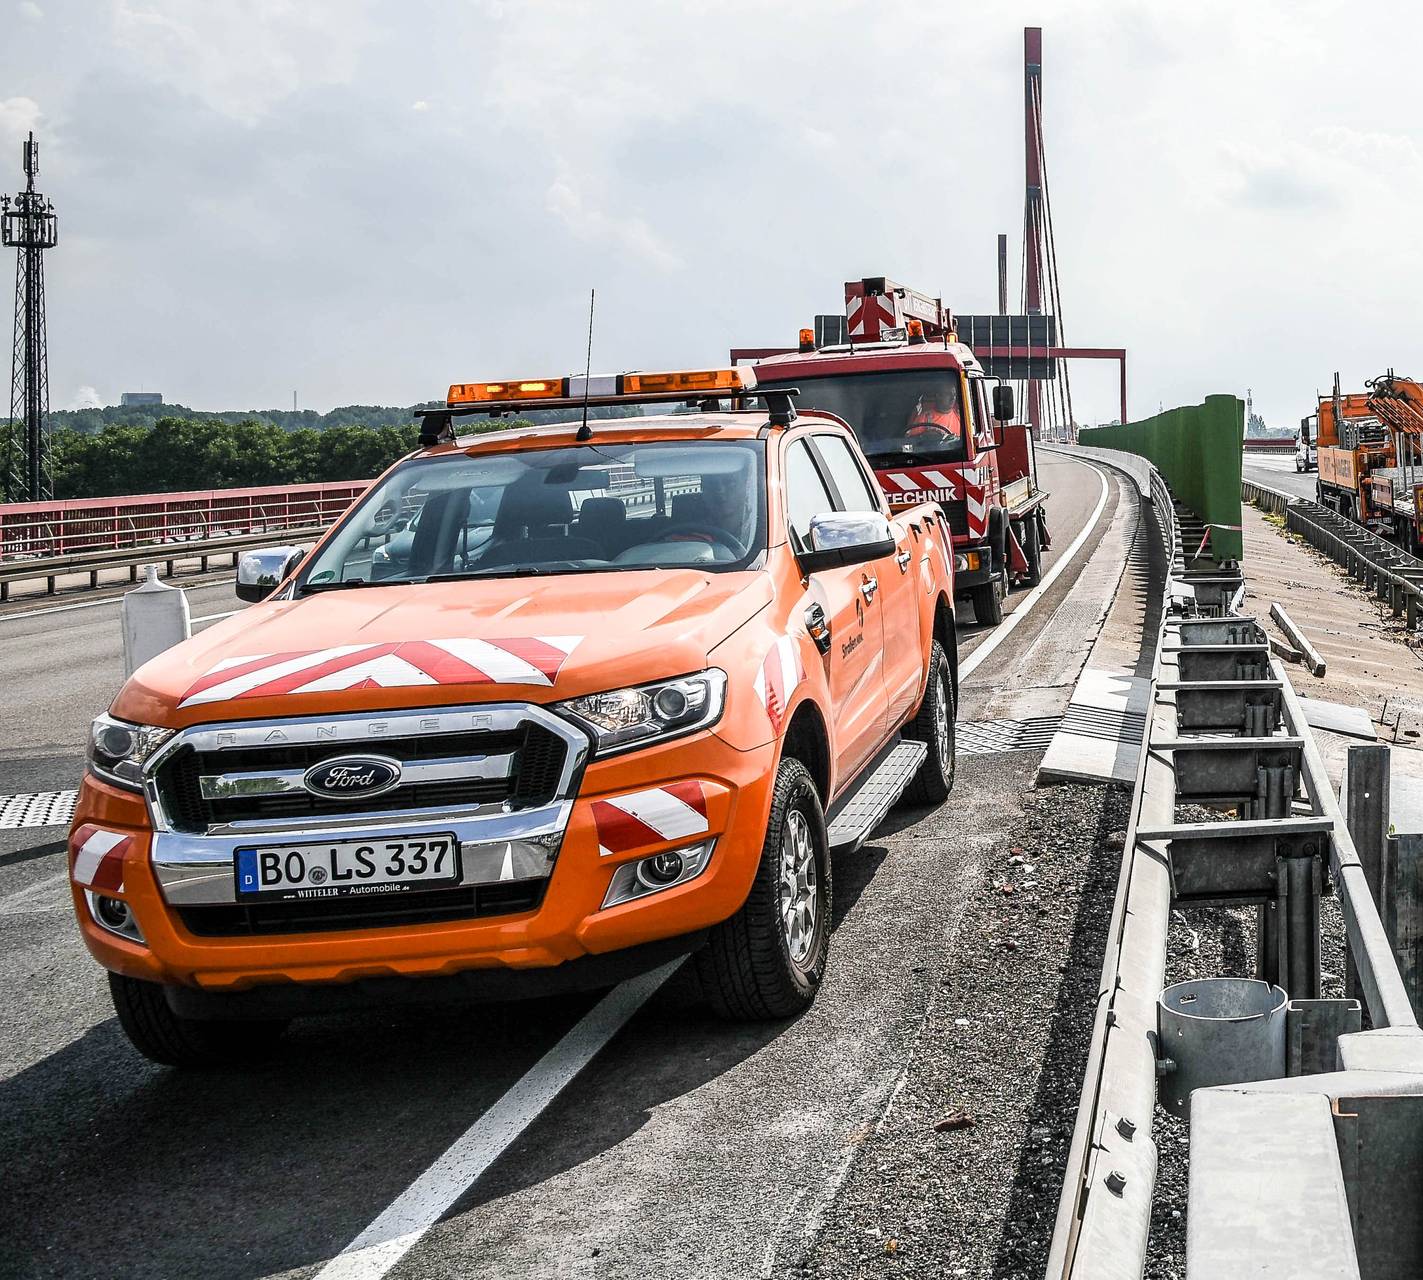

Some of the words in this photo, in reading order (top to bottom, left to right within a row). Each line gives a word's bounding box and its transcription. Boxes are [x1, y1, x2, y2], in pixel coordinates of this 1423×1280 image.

[885, 487, 958, 505] TECHNIK
[216, 714, 493, 745] RANGER
[324, 765, 375, 789] Ford
[260, 851, 306, 886] BO
[331, 846, 376, 881] LS
[385, 840, 449, 878] 337
[245, 874, 253, 885] D
